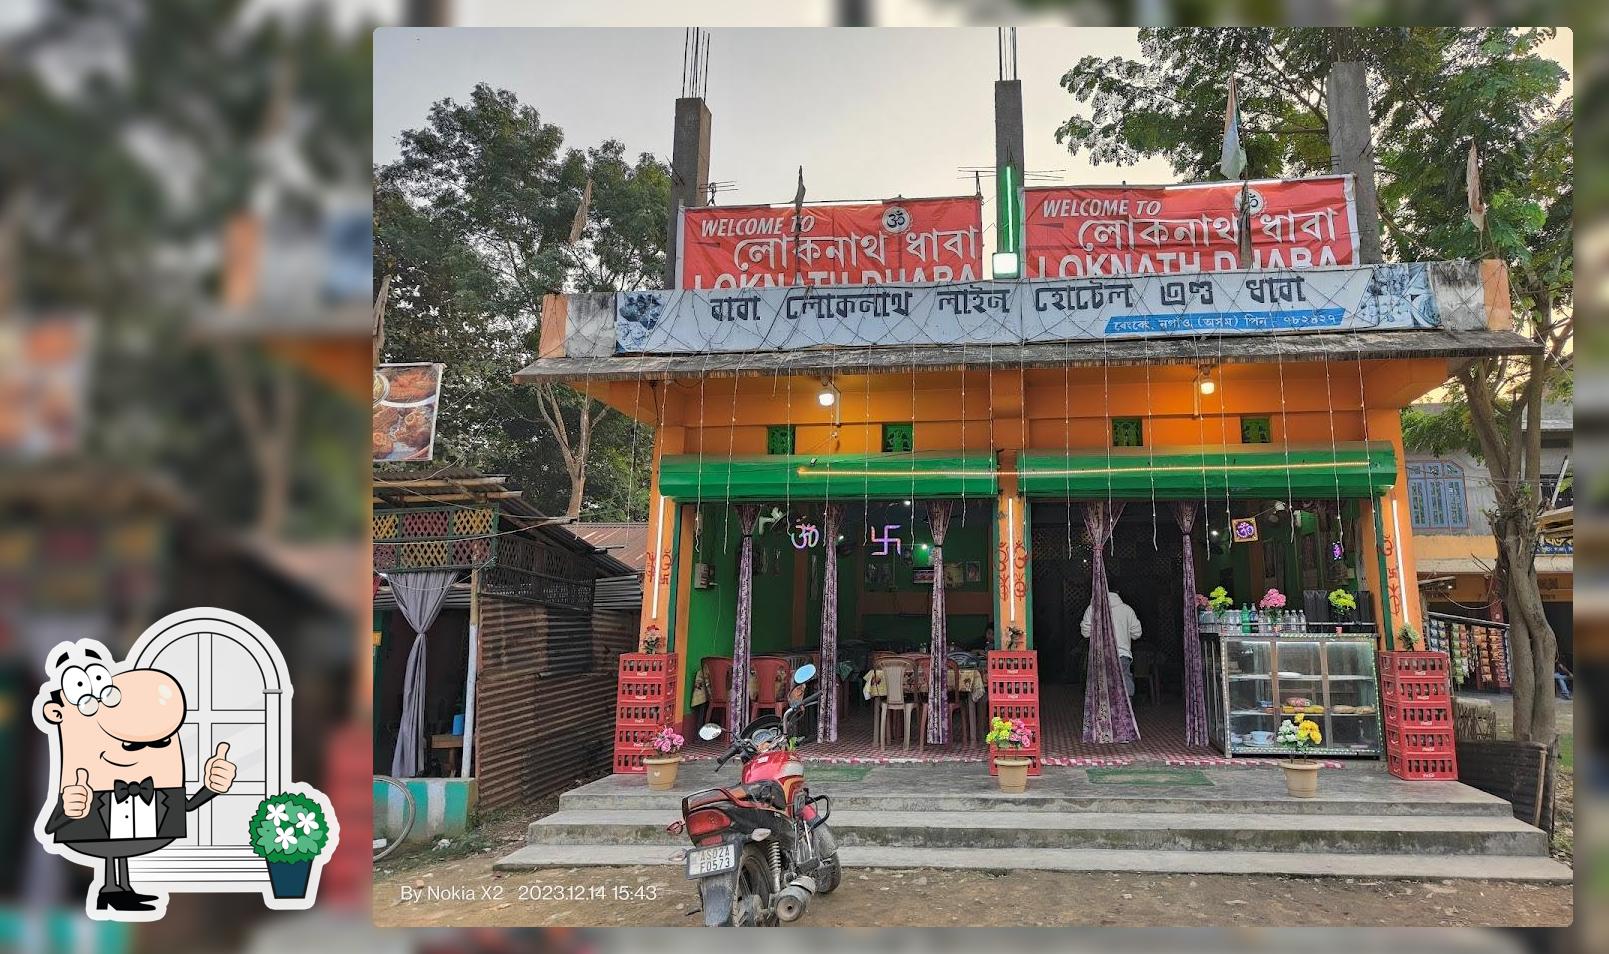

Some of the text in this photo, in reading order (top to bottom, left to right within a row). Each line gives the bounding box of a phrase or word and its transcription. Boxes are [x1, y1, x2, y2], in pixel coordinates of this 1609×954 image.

[1042, 198, 1162, 218] WELCOME TO
[701, 214, 816, 238] WELCOME TO
[1078, 207, 1340, 252] লোকনাথ ধাবা
[734, 227, 979, 272] লোকনাথ ধাবা
[710, 296, 761, 322] বাবা
[786, 291, 913, 320] লোকনাথ
[936, 285, 1011, 315] লাইন
[1035, 280, 1133, 312] হোটেল
[1246, 276, 1306, 303] ধাবা
[700, 857, 731, 873] F0573
